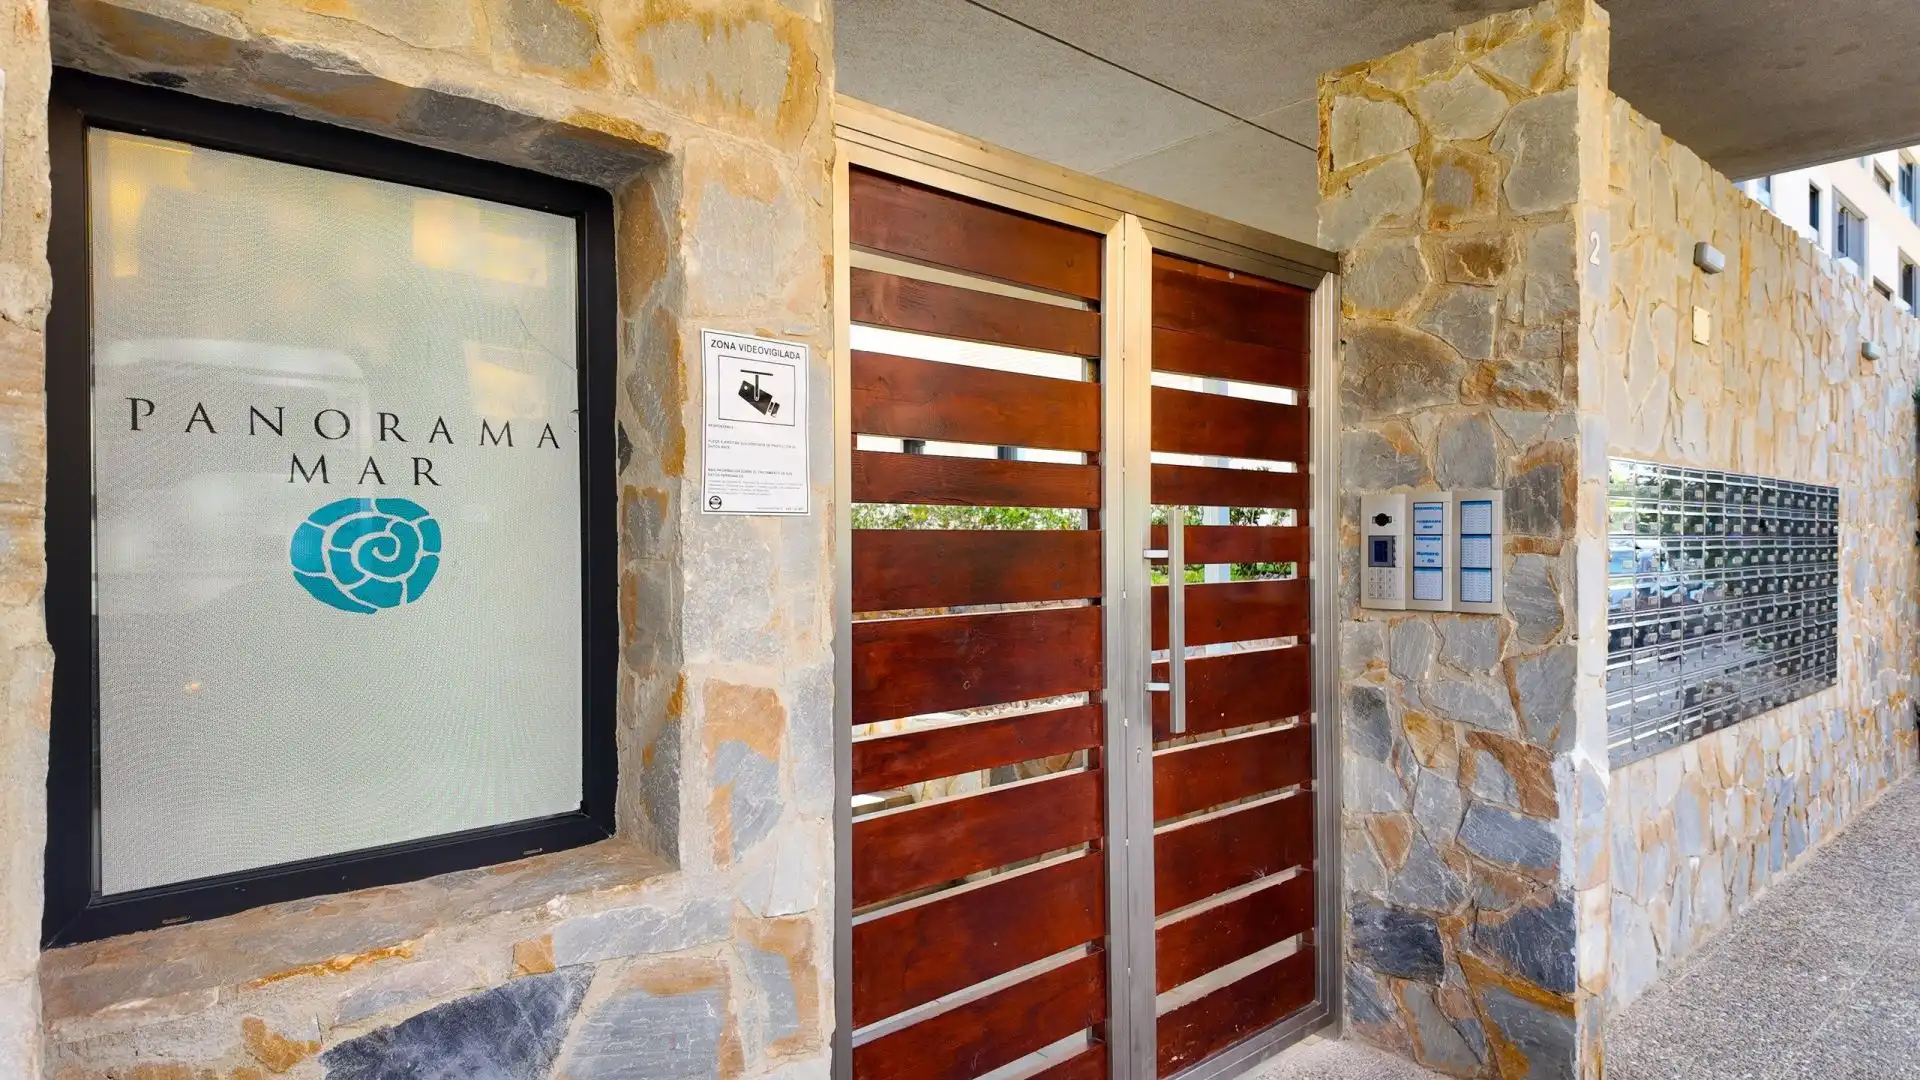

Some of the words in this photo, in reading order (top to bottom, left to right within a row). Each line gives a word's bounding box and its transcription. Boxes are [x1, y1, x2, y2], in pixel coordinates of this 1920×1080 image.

[1589, 231, 1600, 267] 2
[710, 339, 736, 351] ZONA
[738, 343, 801, 360] VIDEOVIGILADA
[125, 397, 561, 450] PANORAMA
[288, 453, 442, 487] MAR
